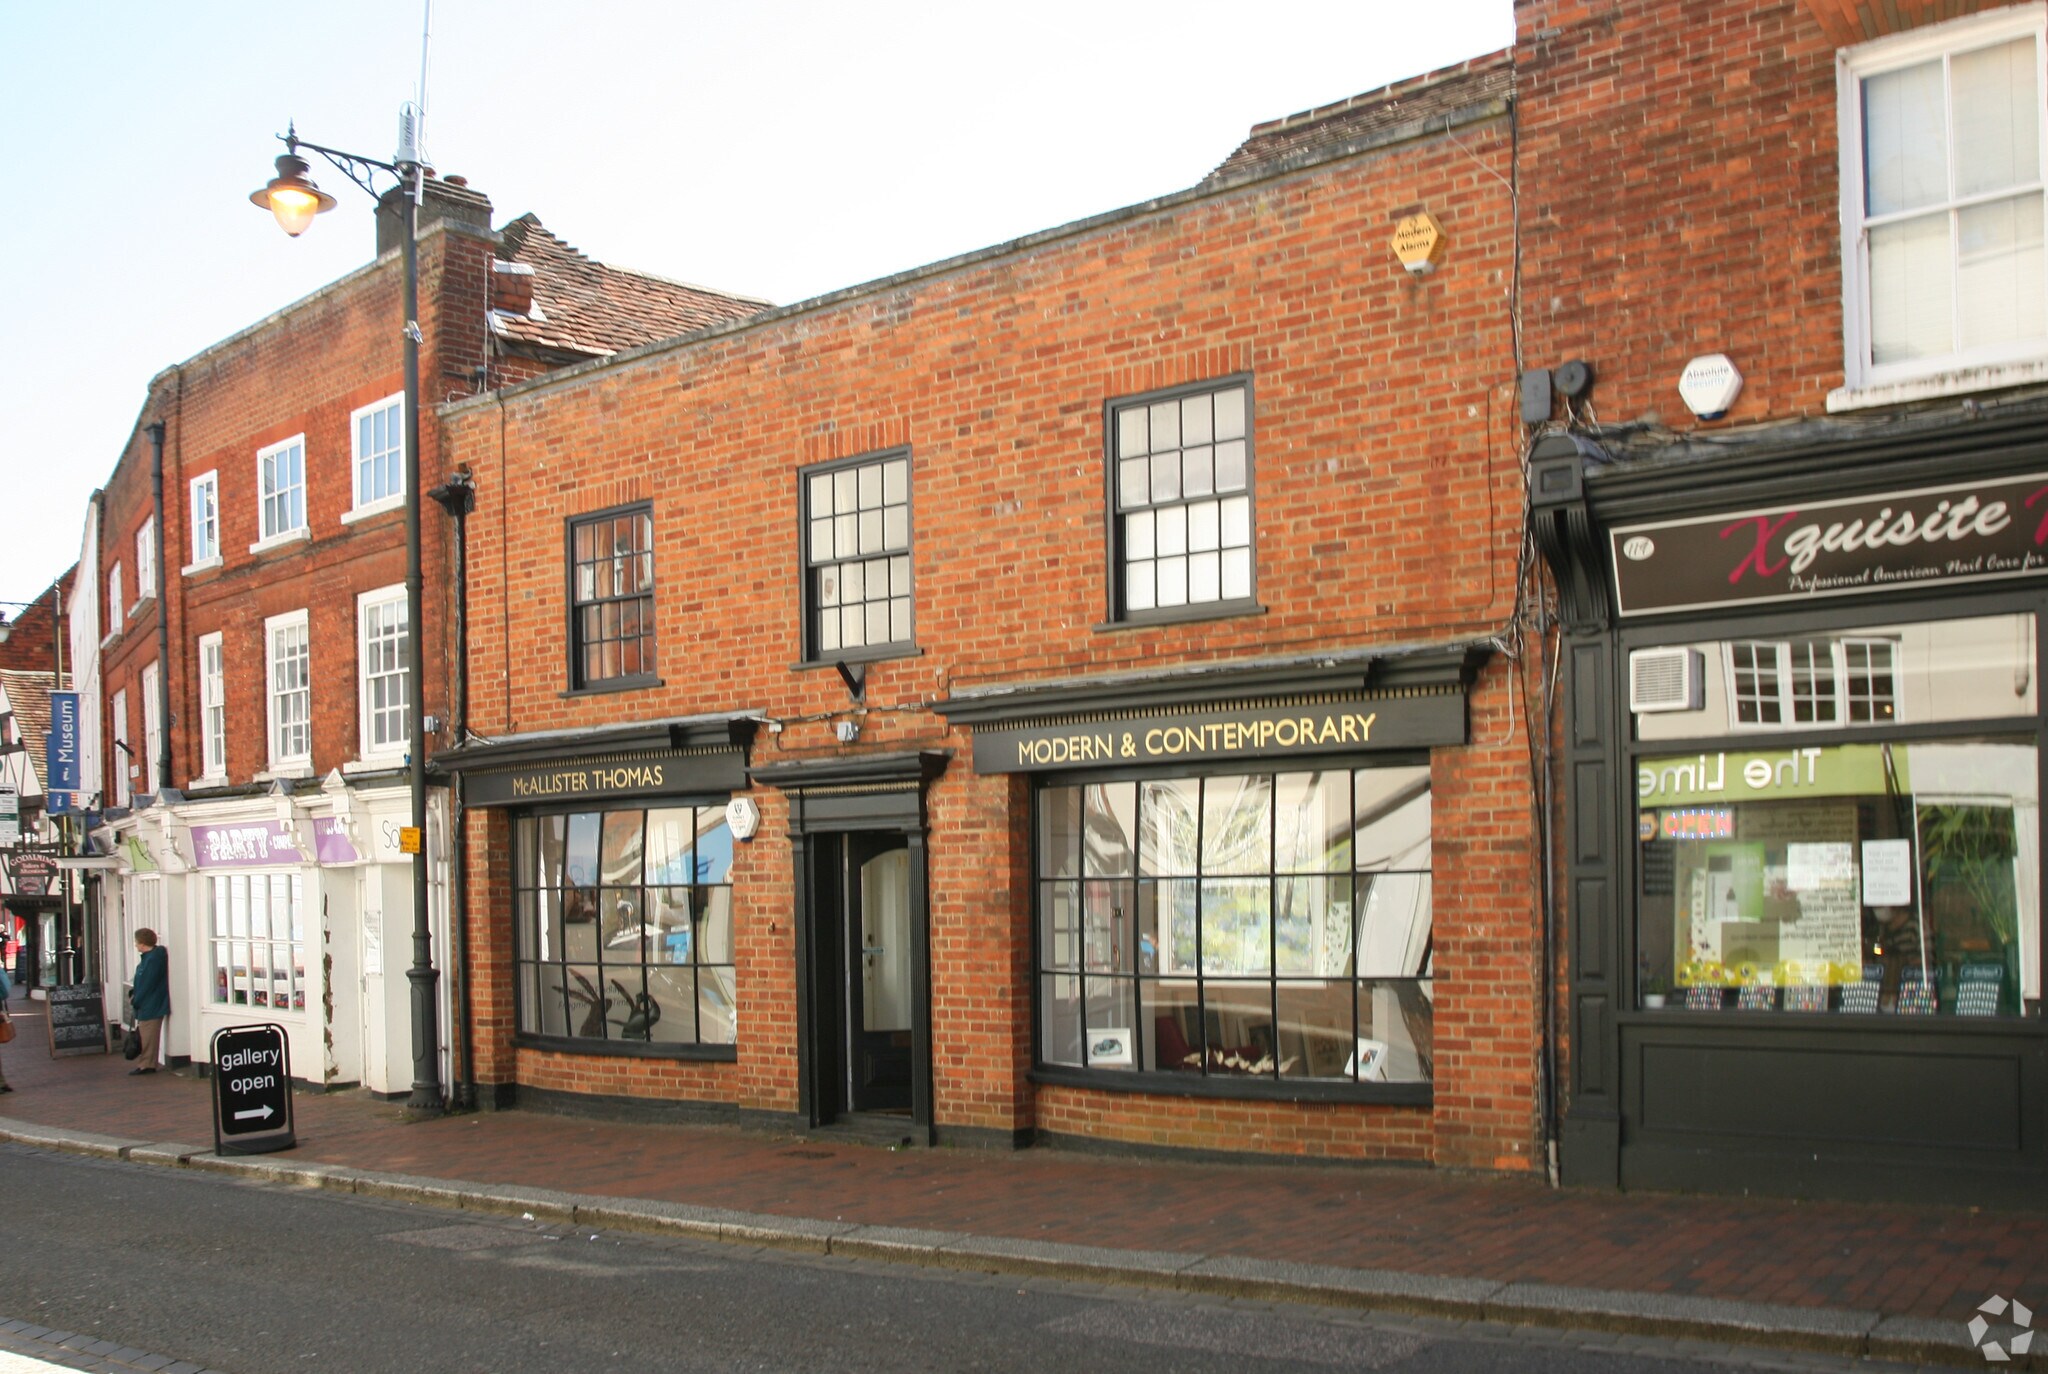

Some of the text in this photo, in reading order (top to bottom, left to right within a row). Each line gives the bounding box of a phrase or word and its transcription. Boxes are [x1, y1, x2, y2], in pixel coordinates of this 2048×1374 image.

[1397, 226, 1431, 240] Modern
[1400, 241, 1429, 253] Alarms
[1686, 366, 1729, 379] Absolute
[1719, 496, 2011, 585] Xquisite
[1788, 550, 2045, 595] Professional American Nail Care for
[58, 700, 73, 762] Museum
[1018, 713, 1376, 765] MODERN & CONTEMPORARY
[513, 765, 663, 796] McALLISTER THOMAS
[1664, 812, 1732, 835] OPEN
[207, 827, 268, 860] PARTY
[221, 1048, 280, 1071] gallery
[231, 1075, 275, 1095] open
